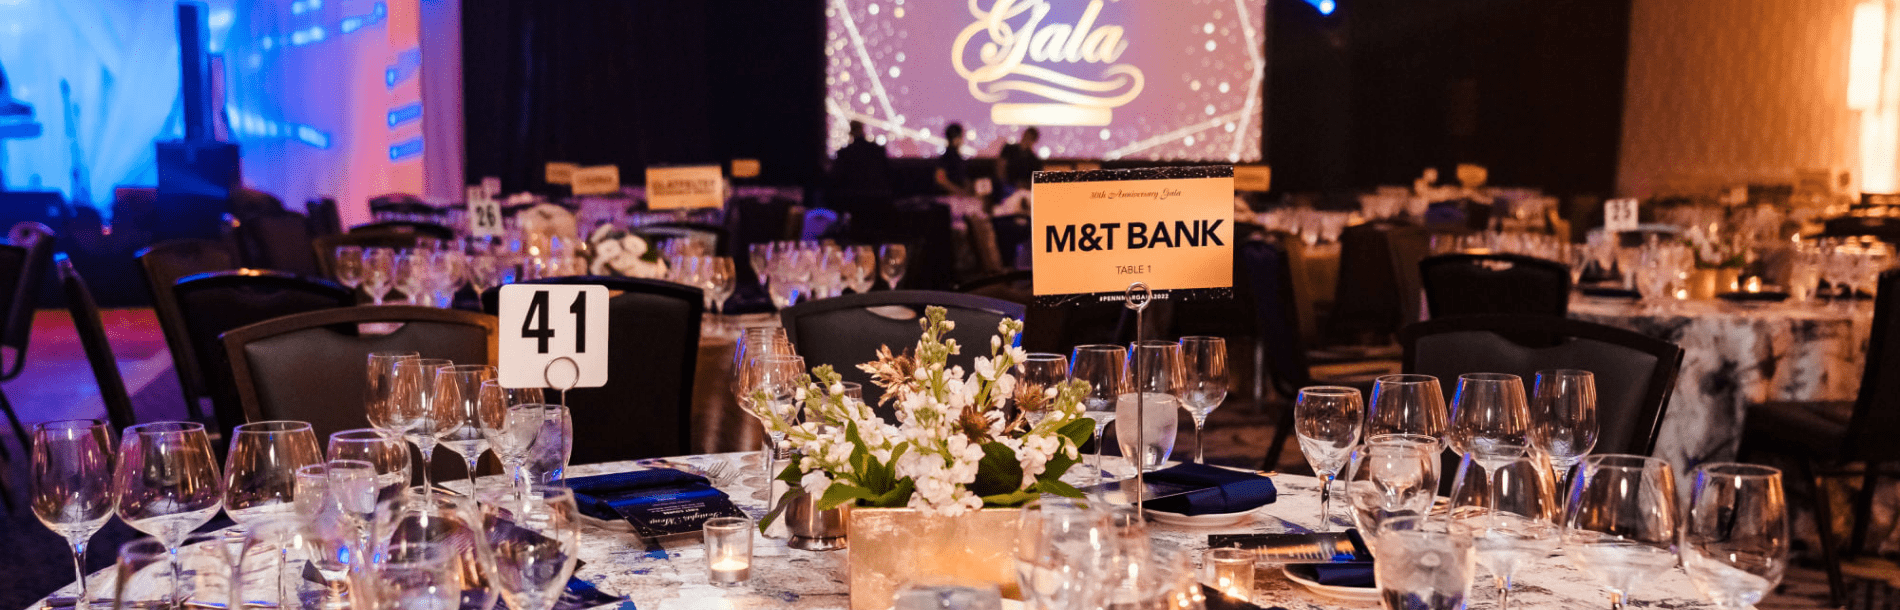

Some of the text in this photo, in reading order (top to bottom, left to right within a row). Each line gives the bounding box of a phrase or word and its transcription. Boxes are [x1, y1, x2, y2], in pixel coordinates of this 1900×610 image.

[951, 0, 1131, 84] Gala
[1107, 188, 1159, 200] Anniversary
[1160, 187, 1181, 200] Gala
[475, 204, 497, 228] 26
[1045, 218, 1225, 253] M&T BANK
[1115, 264, 1145, 275] TABLE
[521, 290, 587, 354] 41
